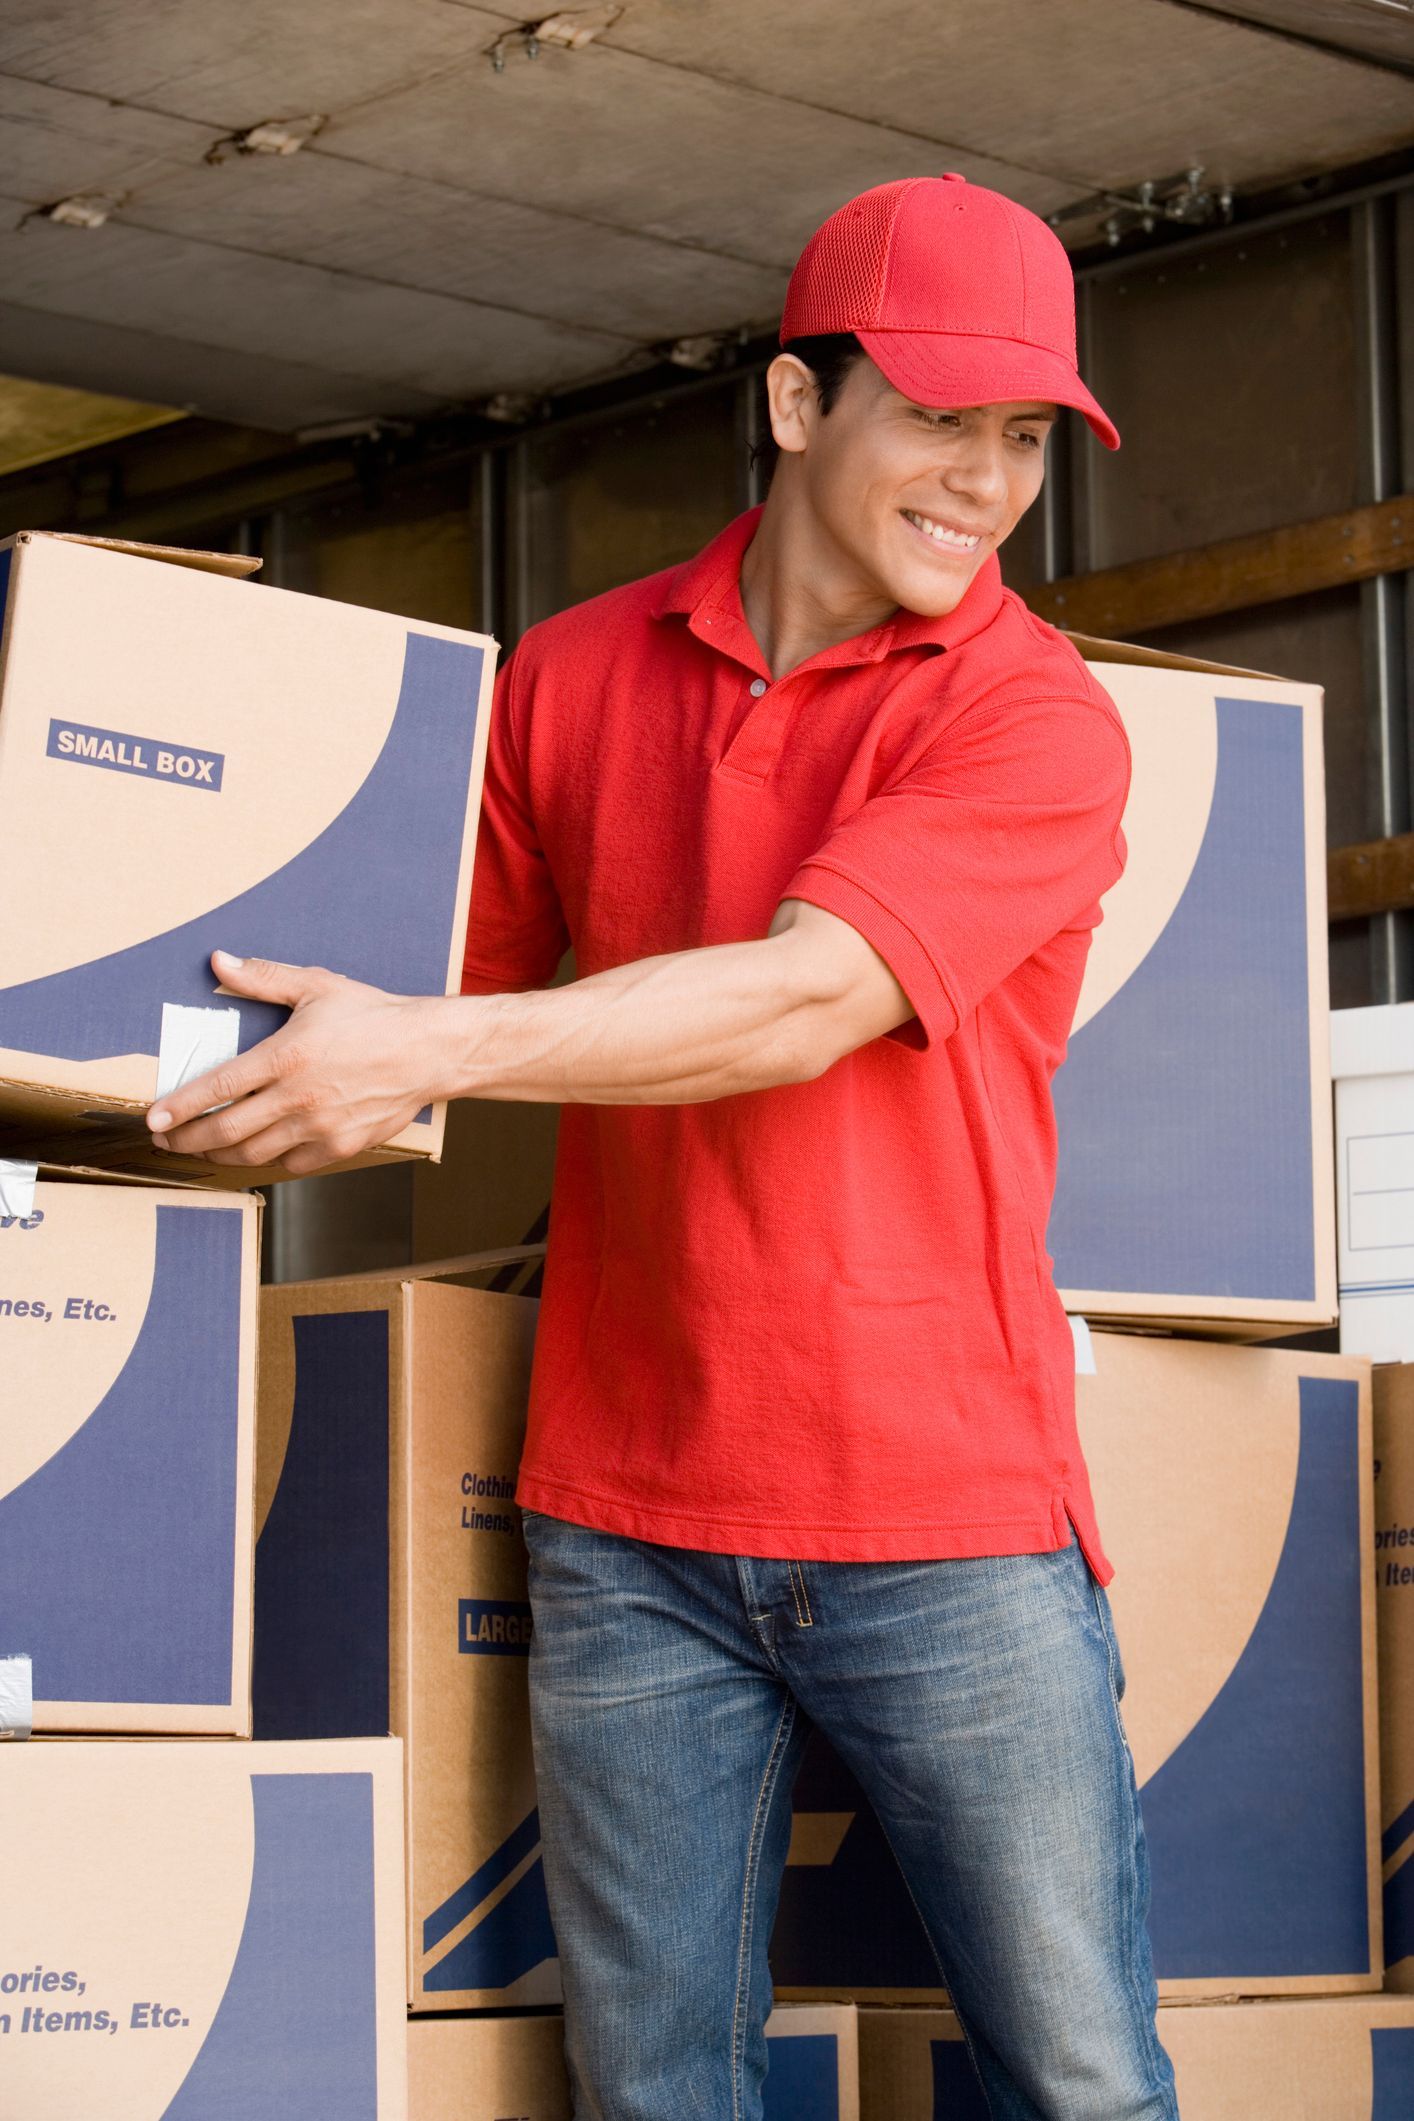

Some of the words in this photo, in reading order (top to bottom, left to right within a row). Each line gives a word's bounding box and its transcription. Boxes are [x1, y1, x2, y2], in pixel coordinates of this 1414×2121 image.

[57, 730, 148, 769] SMALL
[156, 750, 215, 783] BOX
[63, 1297, 117, 1321] Etc.
[462, 1506, 514, 1536] Linens,
[1386, 1562, 1414, 1586] Ite
[465, 1612, 532, 1644] LARGE
[1, 1965, 86, 1996] ories,
[21, 2007, 118, 2035] Items,
[130, 2002, 190, 2029] Etc.
